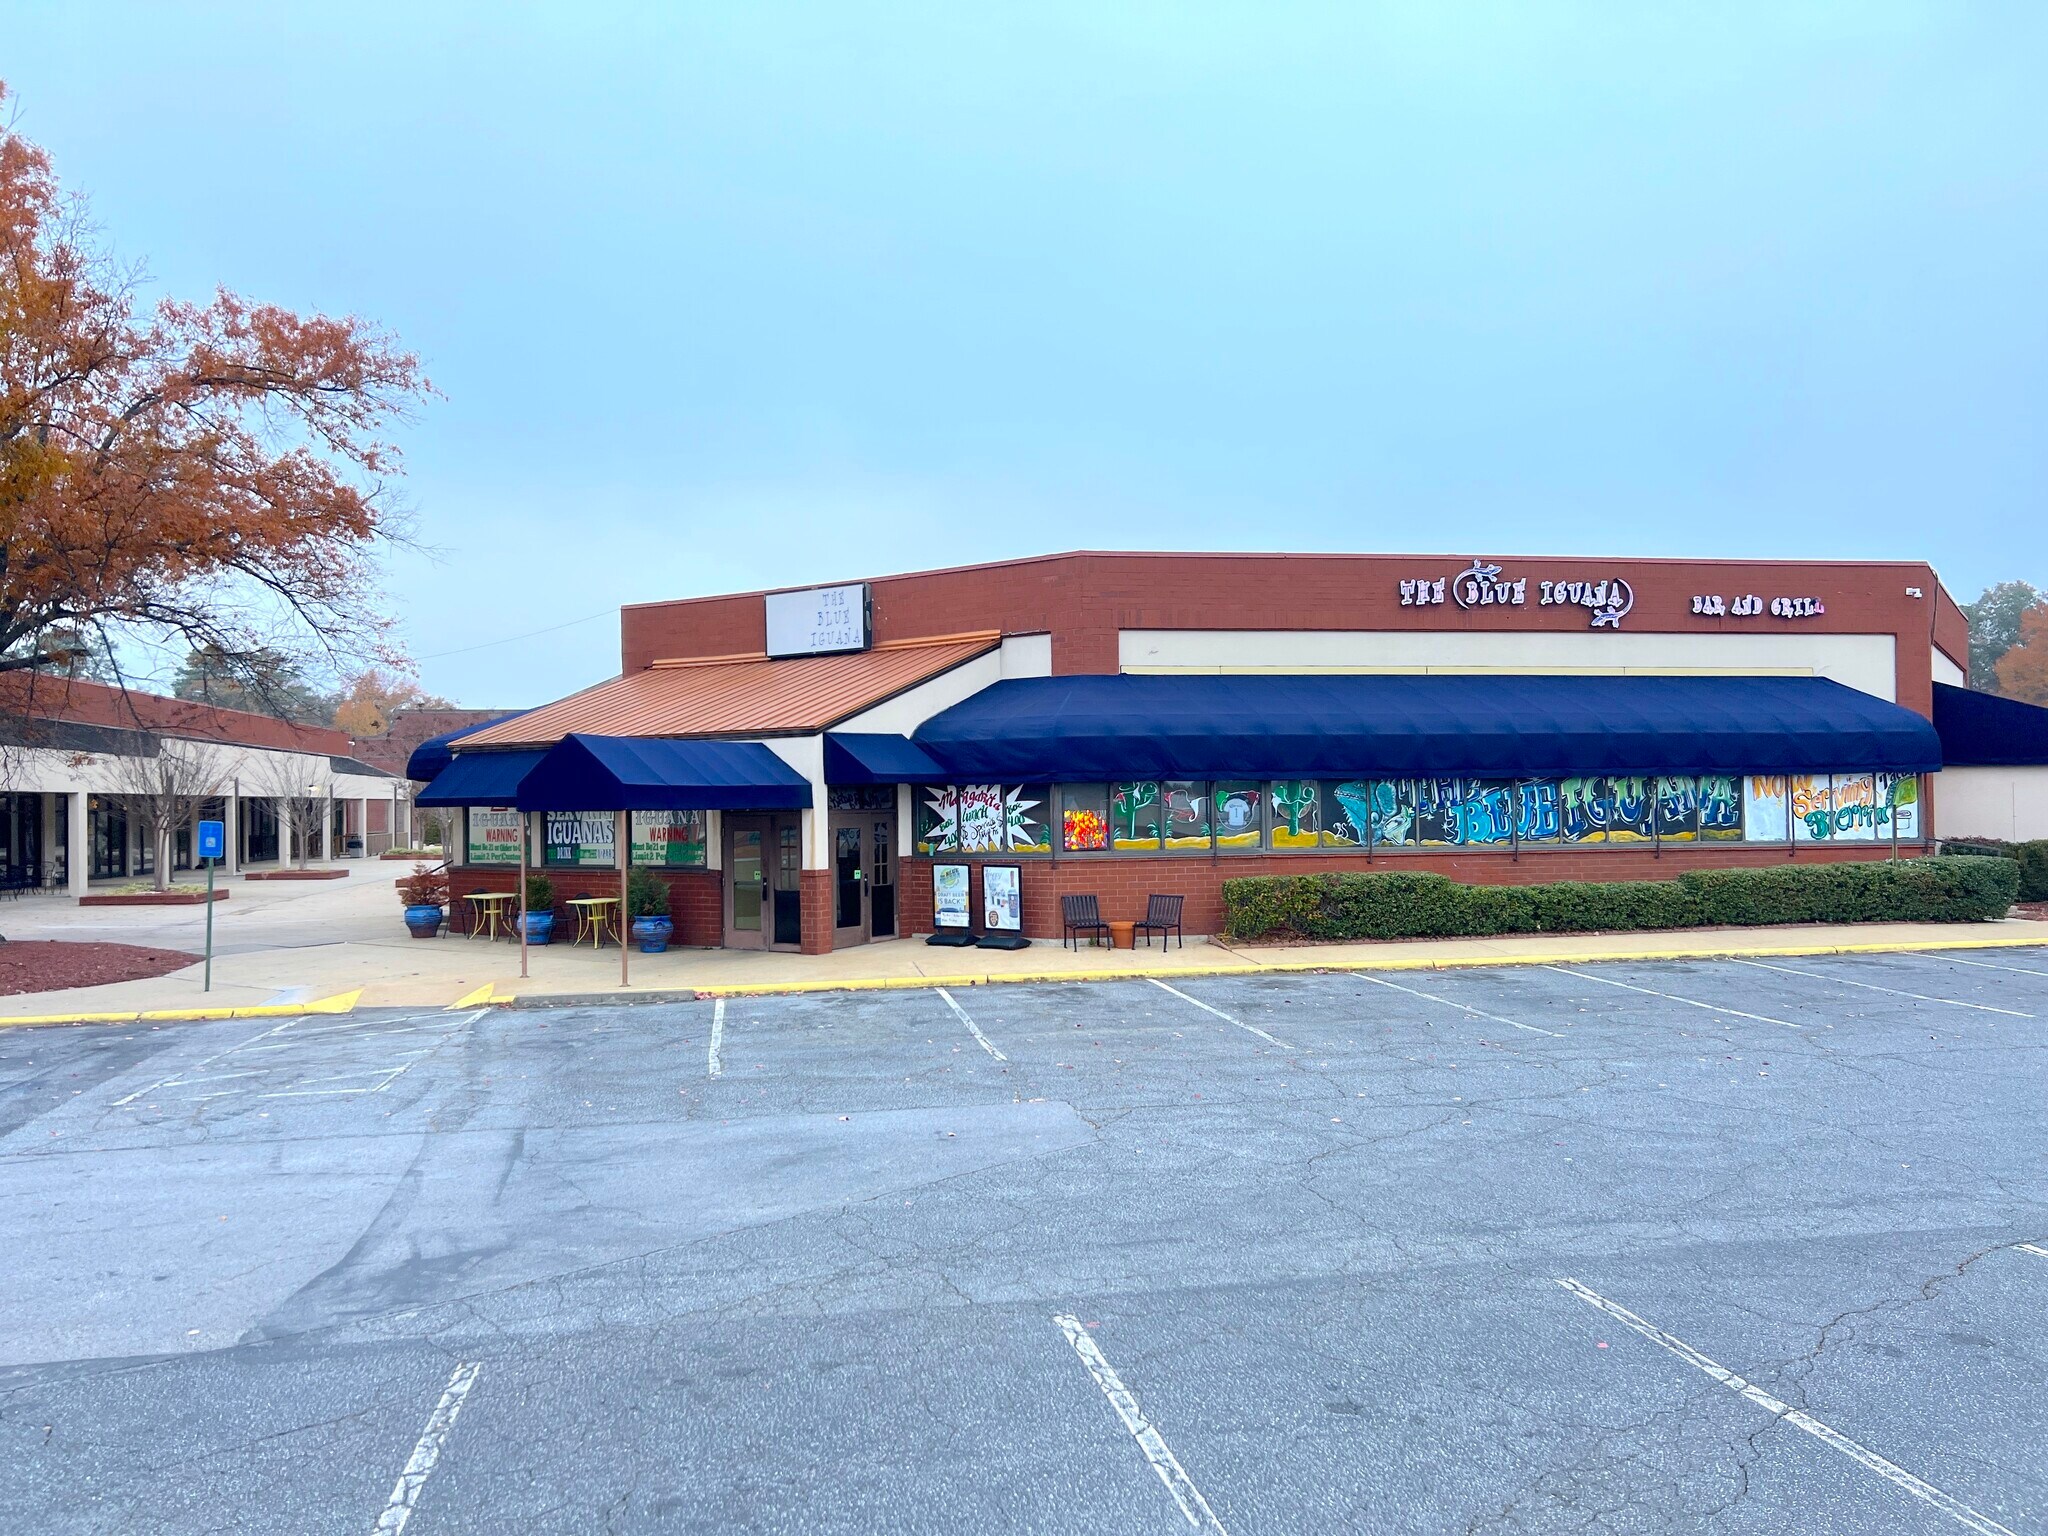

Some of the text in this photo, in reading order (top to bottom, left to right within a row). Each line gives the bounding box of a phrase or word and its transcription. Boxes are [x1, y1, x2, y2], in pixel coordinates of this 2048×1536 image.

[823, 590, 844, 606] THE
[1400, 577, 1624, 608] THE BLUE IGUANA
[817, 608, 849, 626] BLUE
[1692, 594, 1825, 619] BAR AND GRILL
[811, 628, 860, 647] IGUANA
[1751, 774, 1813, 801] NOW
[1792, 775, 1873, 820] Serving
[635, 809, 701, 826] IGUANA
[1561, 776, 1740, 841] IGUANA
[486, 828, 518, 842] WARNING
[547, 821, 614, 844] IGUANAS
[491, 853, 501, 861] Per
